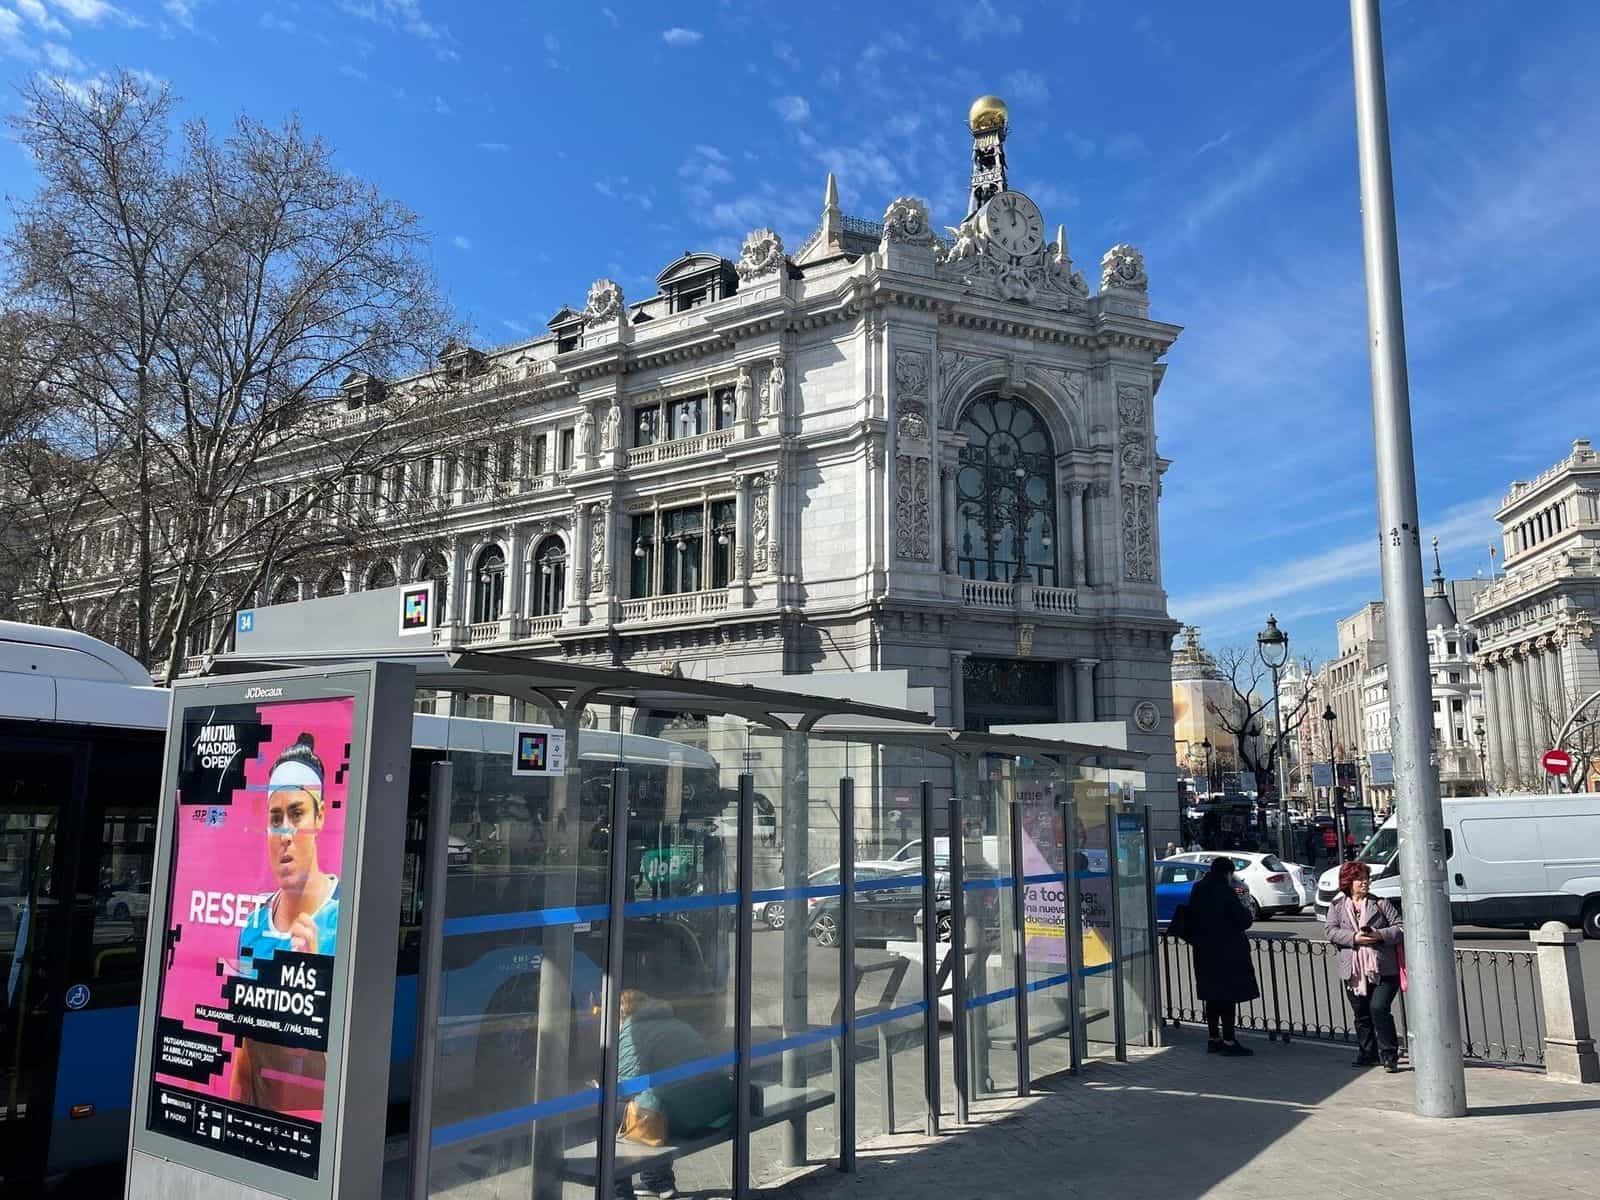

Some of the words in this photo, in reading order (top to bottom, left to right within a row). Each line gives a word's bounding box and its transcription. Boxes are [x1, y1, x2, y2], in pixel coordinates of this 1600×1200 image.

[240, 615, 251, 630] 34
[245, 687, 283, 699] JCDecaux
[200, 724, 235, 742] MUTUA
[197, 741, 237, 755] MADRID
[201, 755, 232, 769] OPEN
